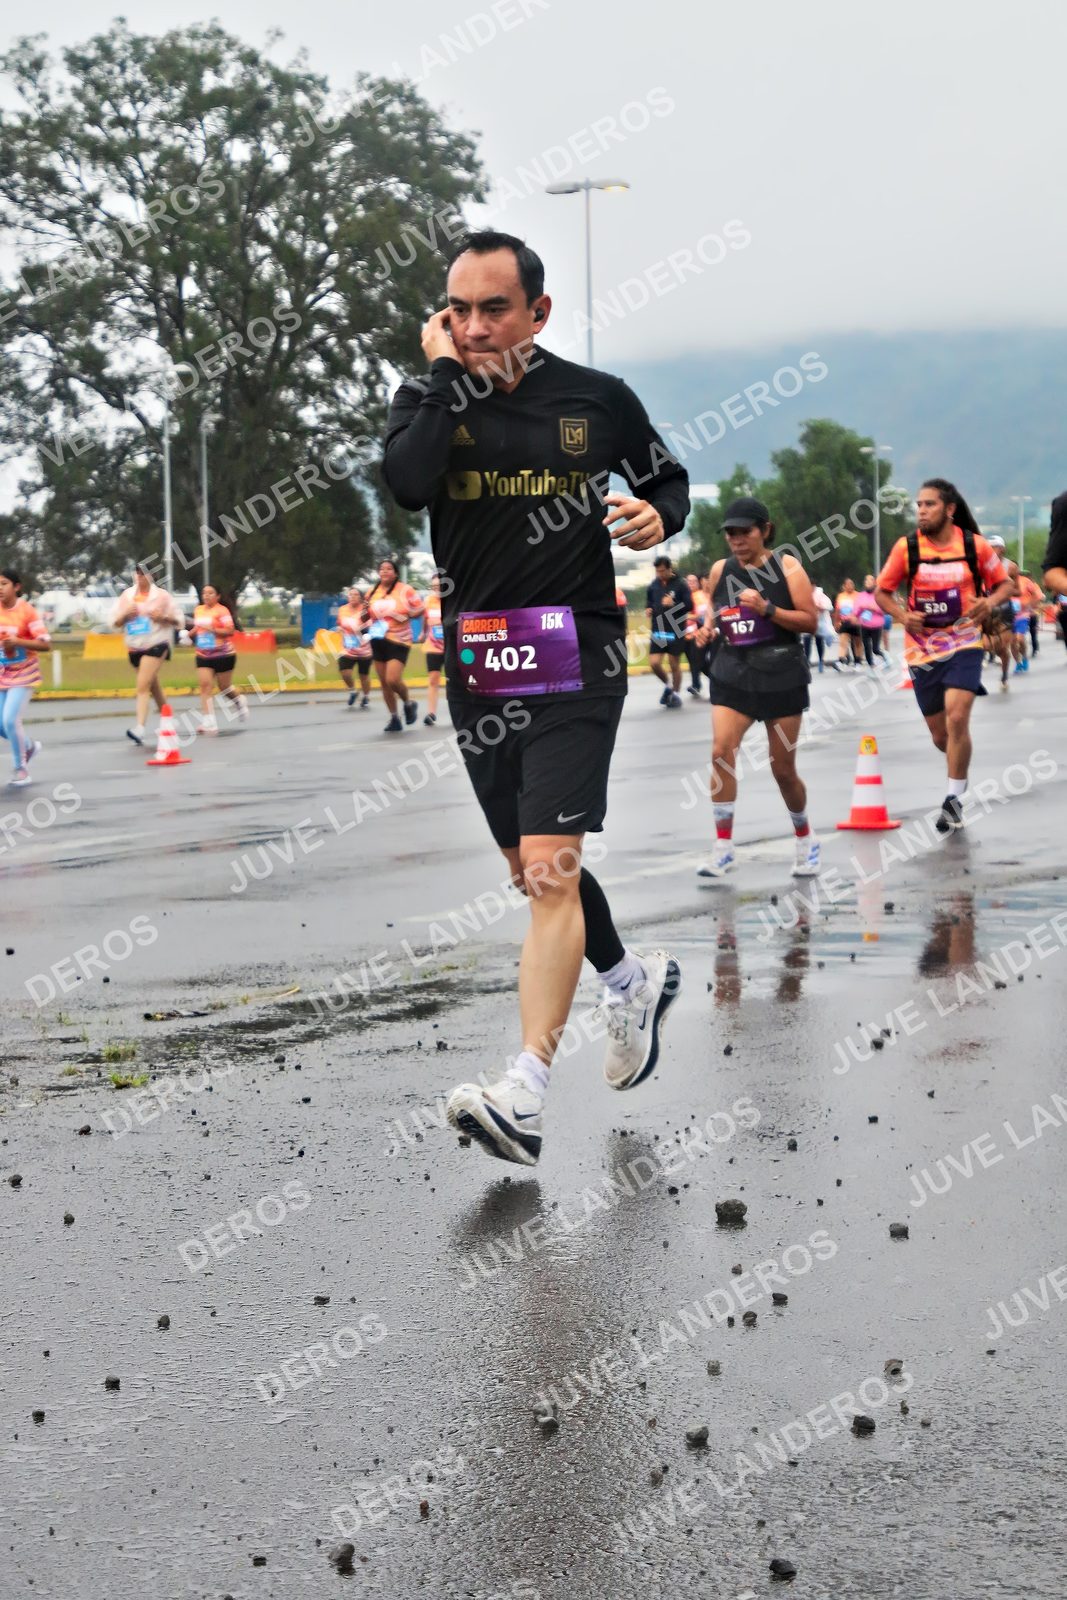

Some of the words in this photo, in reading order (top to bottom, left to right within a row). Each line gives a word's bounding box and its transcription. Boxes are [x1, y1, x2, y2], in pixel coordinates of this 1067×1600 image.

[924, 602, 948, 613] 520
[462, 618, 508, 633] CARRERA
[541, 612, 564, 630] 15K
[730, 619, 755, 634] 167
[484, 645, 538, 672] 402
